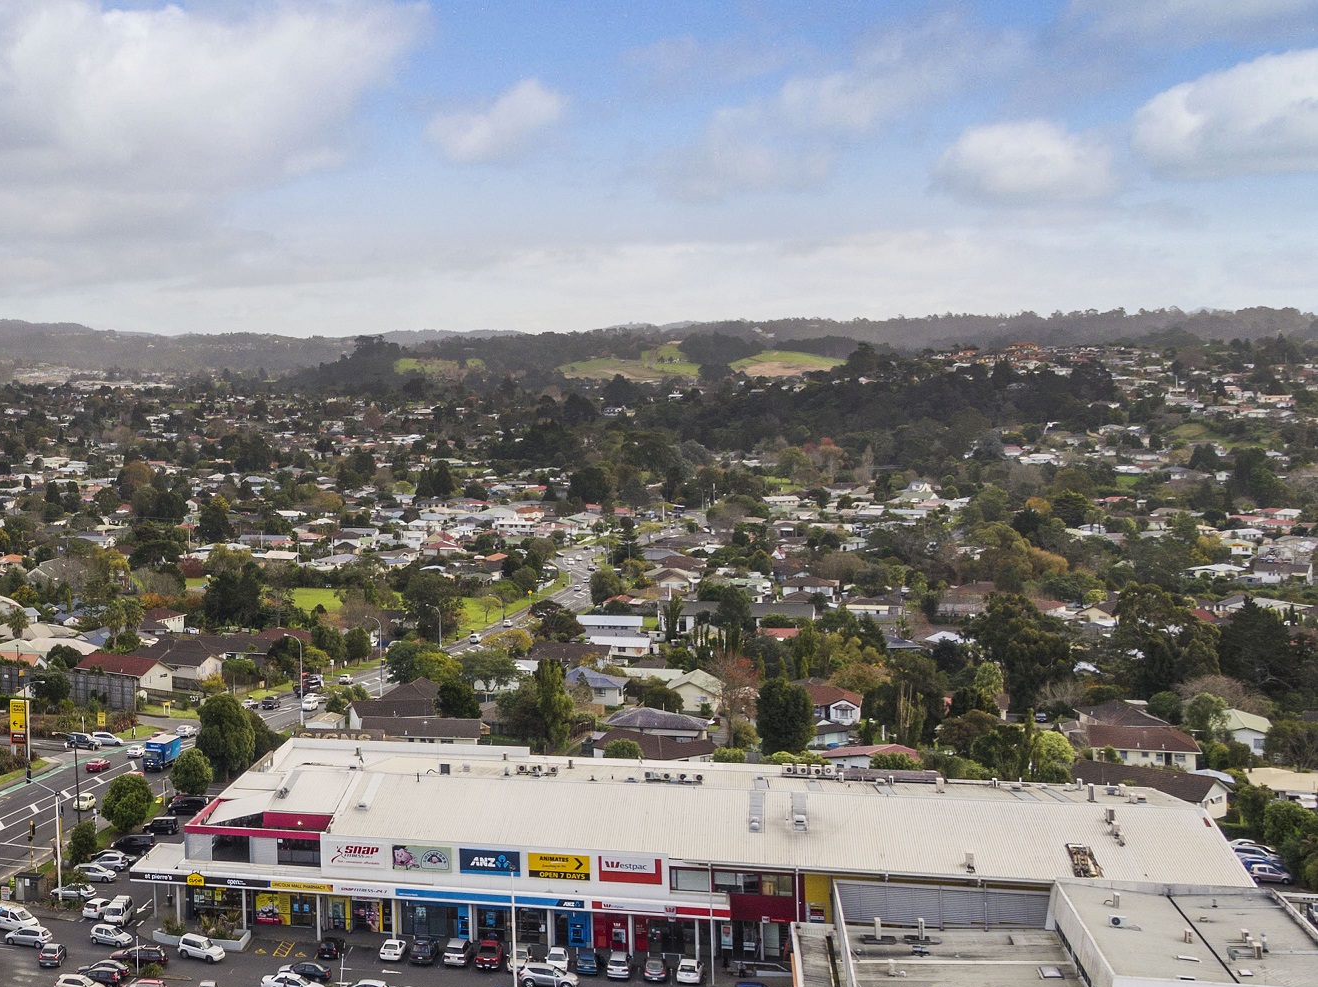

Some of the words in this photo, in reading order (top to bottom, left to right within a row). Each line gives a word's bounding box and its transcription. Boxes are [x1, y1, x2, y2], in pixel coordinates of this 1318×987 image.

[470, 856, 495, 868] ANZ
[539, 855, 569, 863] ANIMATES
[604, 860, 647, 871] Westpac
